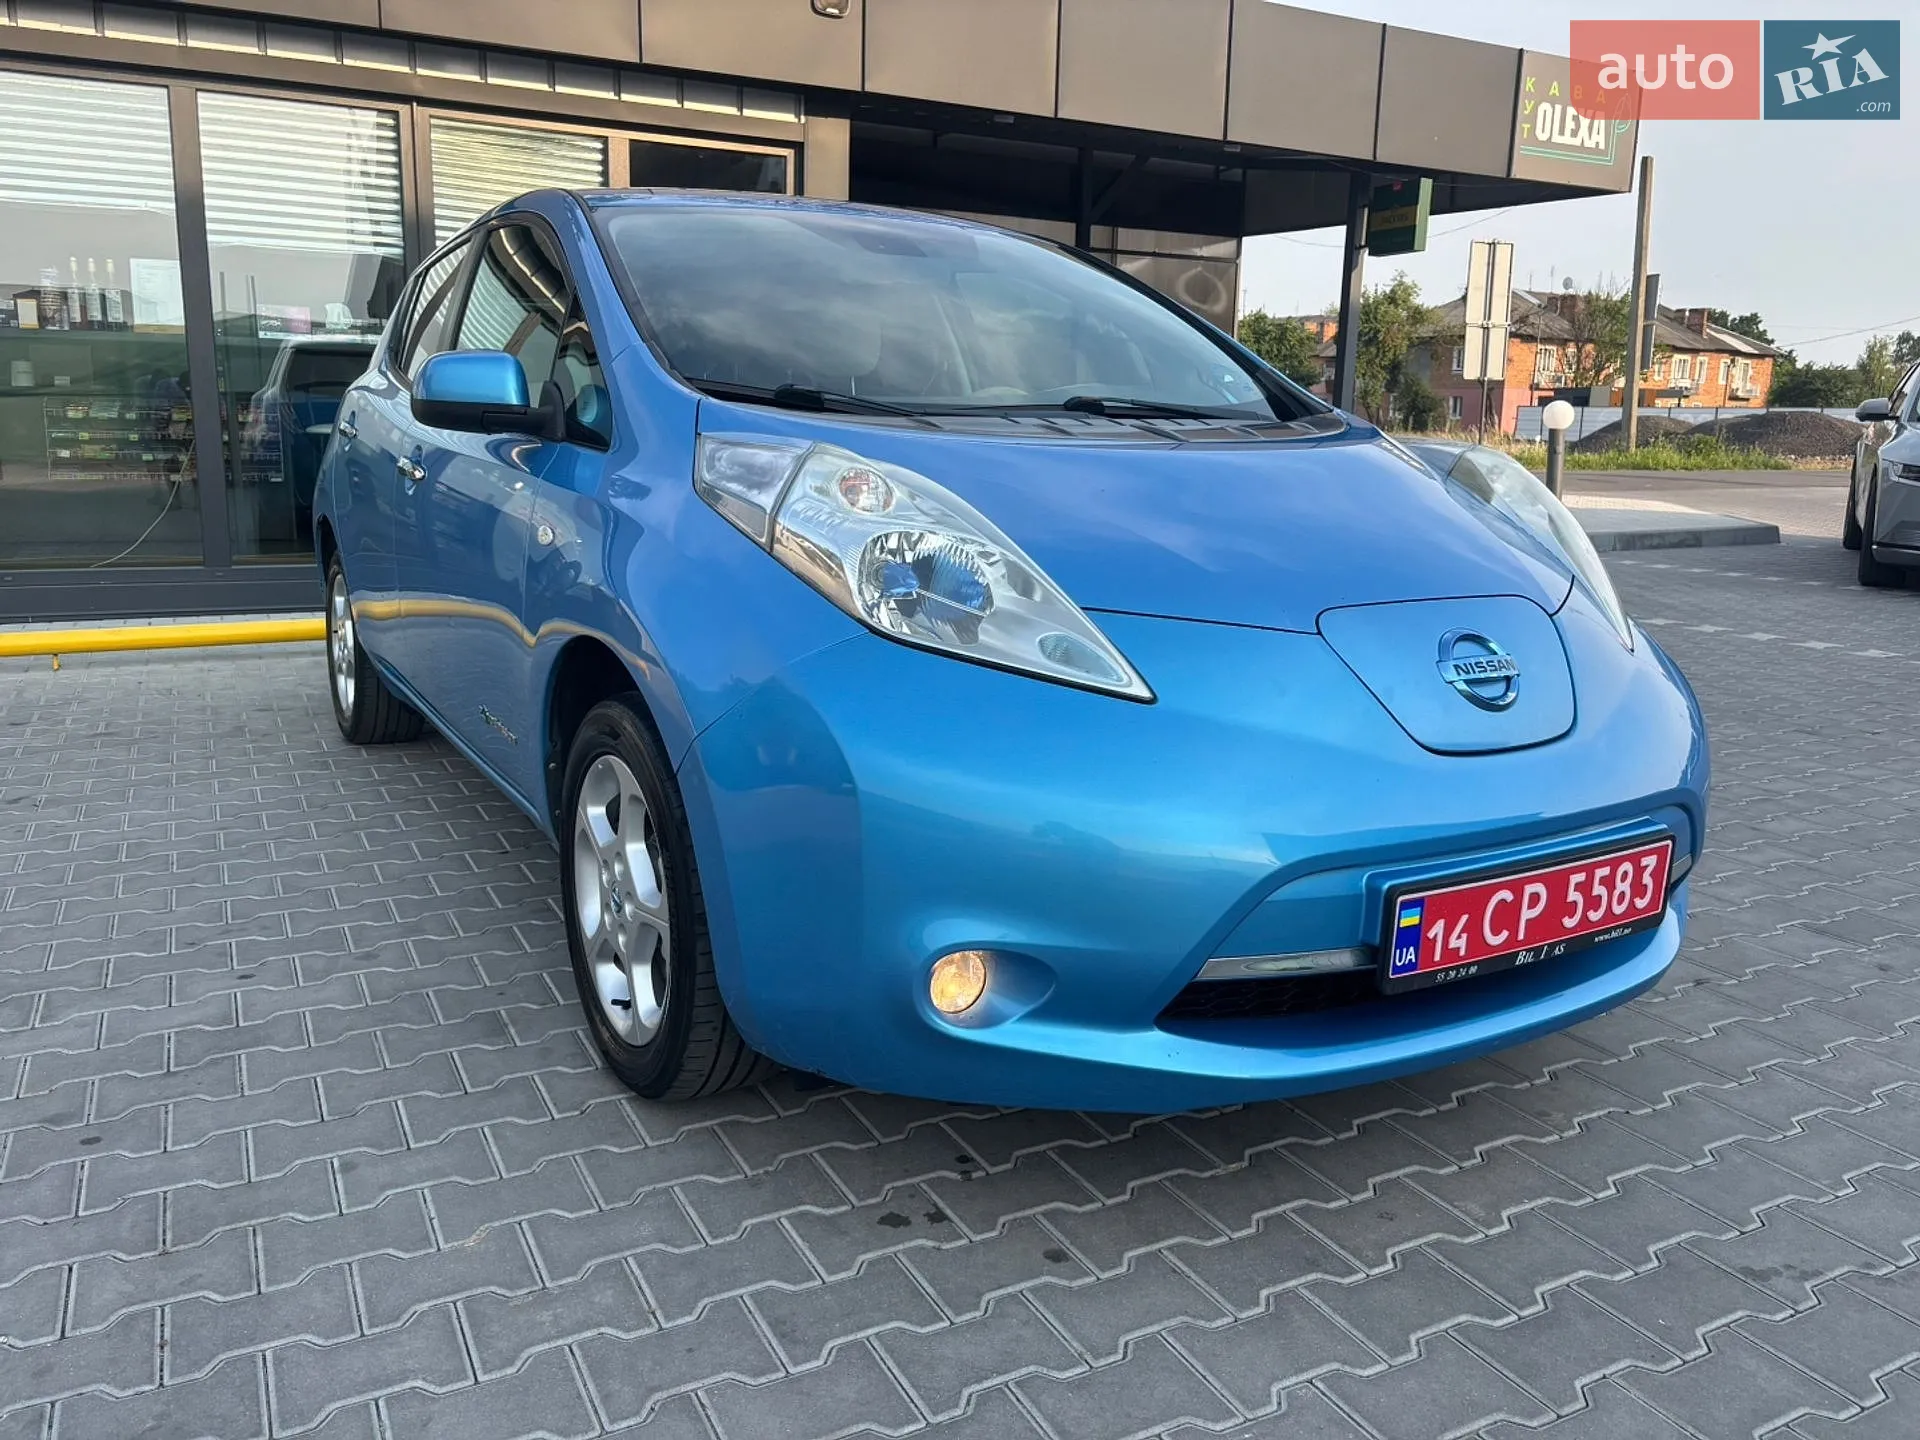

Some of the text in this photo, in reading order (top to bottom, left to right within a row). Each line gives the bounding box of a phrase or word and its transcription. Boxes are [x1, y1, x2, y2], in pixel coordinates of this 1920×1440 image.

[1535, 101, 1606, 150] OLEXA
[1452, 658, 1517, 677] NISSAN
[1427, 854, 1658, 962] 14 CP 5583
[1395, 946, 1416, 966] UA
